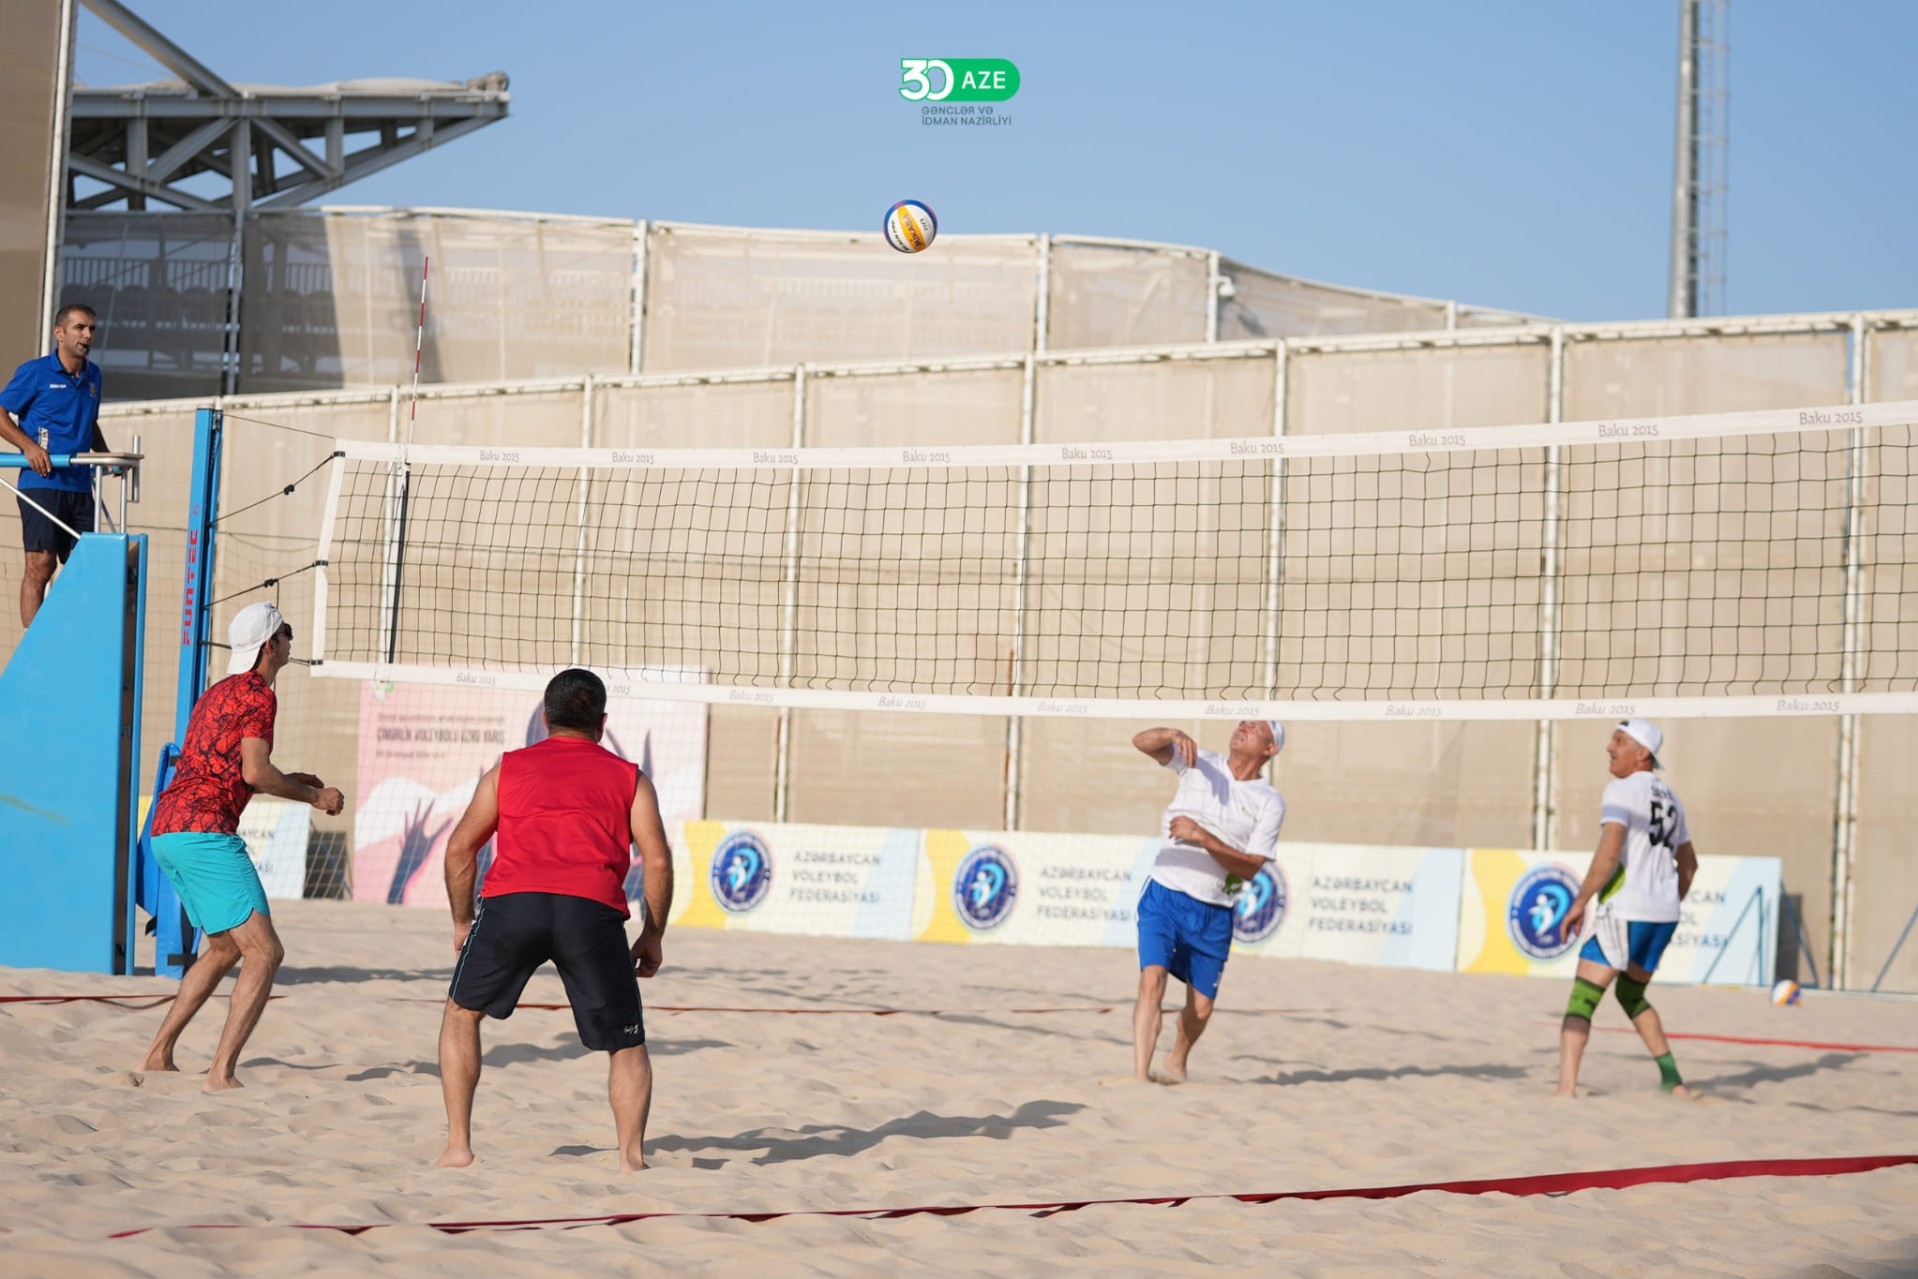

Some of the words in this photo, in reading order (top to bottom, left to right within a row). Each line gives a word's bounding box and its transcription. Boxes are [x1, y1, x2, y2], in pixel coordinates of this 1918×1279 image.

[1799, 411, 1831, 425] Baku
[1835, 412, 1862, 424] 2015
[1598, 424, 1629, 437] Baku
[1632, 424, 1658, 437] 2015
[1409, 434, 1437, 447] Baku
[1440, 435, 1466, 447] 2015
[1061, 448, 1088, 460] Baku
[1090, 449, 1113, 460] 2015
[1230, 442, 1257, 455] Baku
[1260, 442, 1284, 454] 2015
[479, 450, 500, 461] Baku
[502, 452, 520, 463] 2015
[612, 452, 634, 463] Baku
[636, 453, 655, 465] 2015
[753, 452, 777, 463] Baku
[778, 454, 799, 465] 2015
[902, 450, 928, 463] Baku
[929, 452, 952, 464] 2015
[1648, 800, 1680, 851] 52
[792, 870, 858, 884] VOLEYBOL
[1312, 876, 1413, 893] AZƏRBAYCAN
[1039, 886, 1108, 900] VOLEYBOL
[1311, 897, 1388, 914] VOLEYBOL
